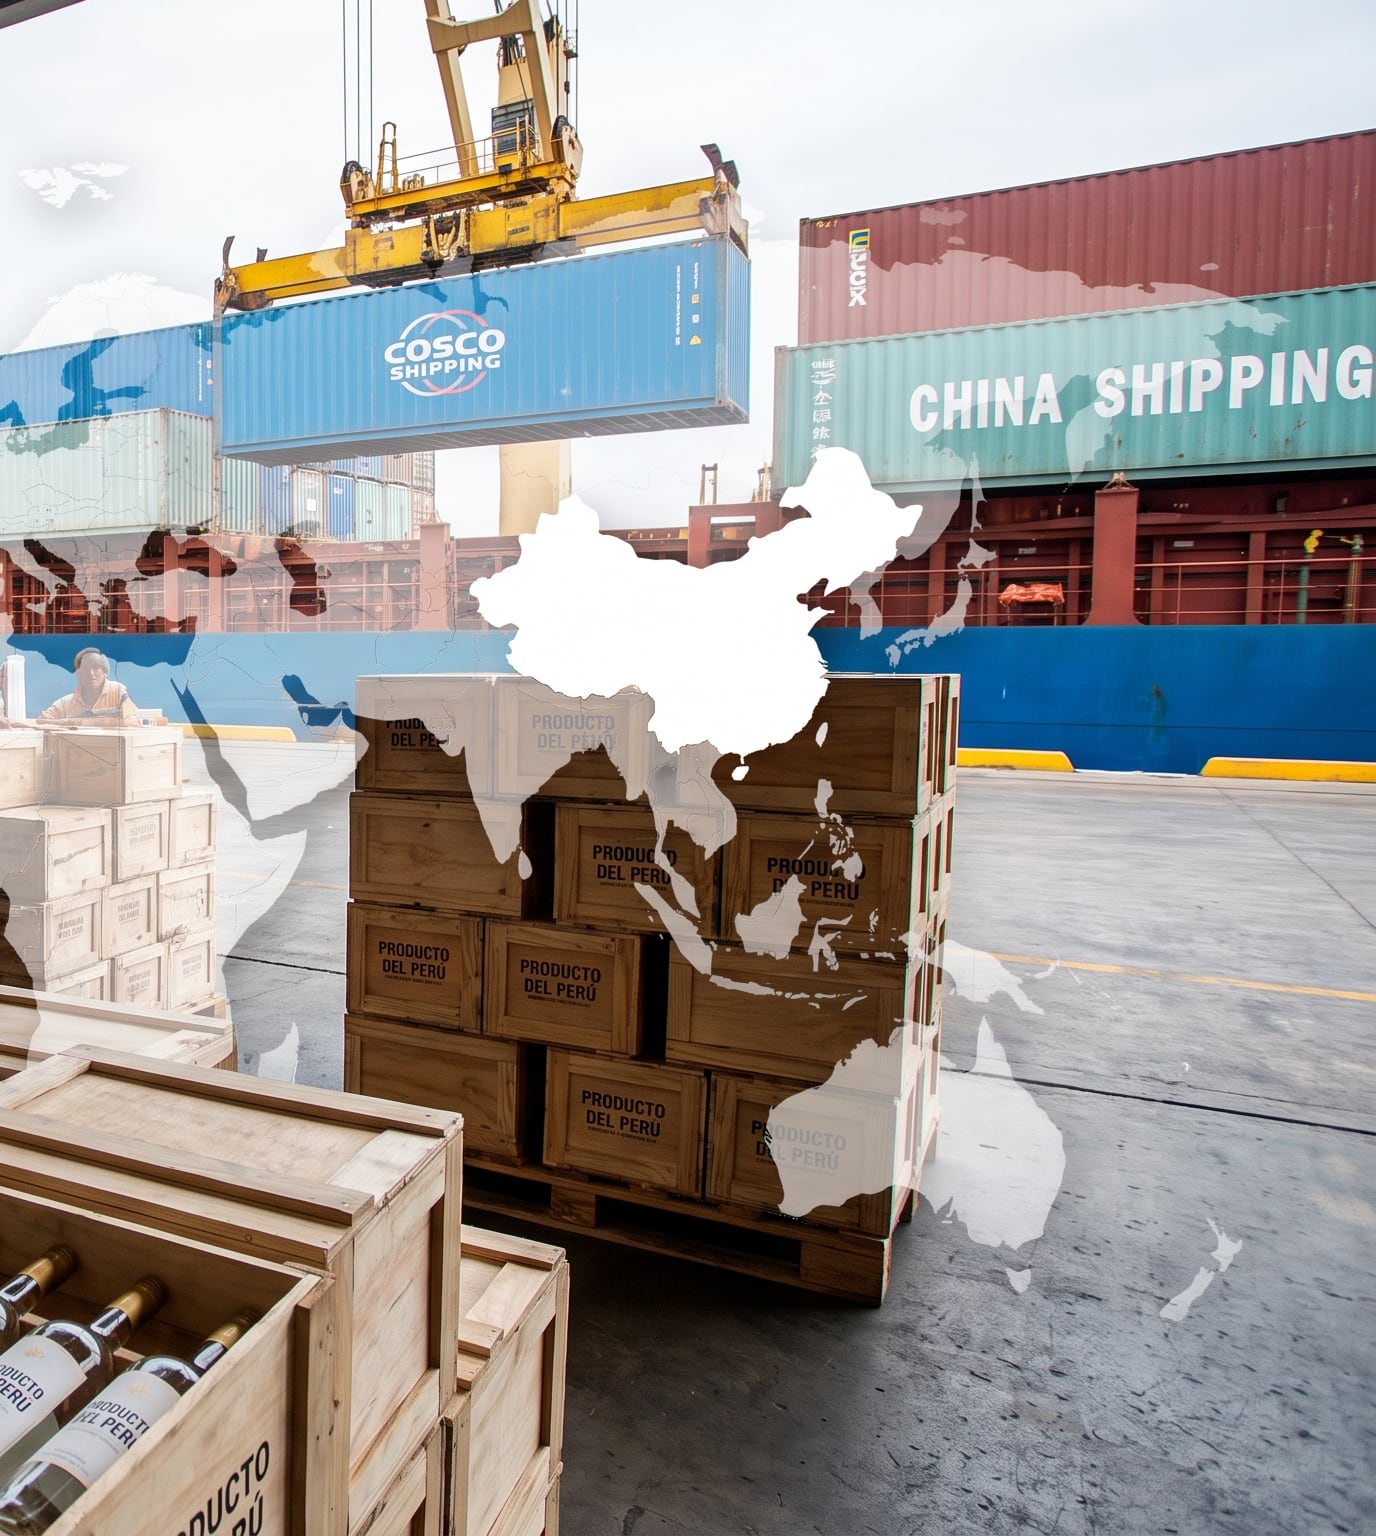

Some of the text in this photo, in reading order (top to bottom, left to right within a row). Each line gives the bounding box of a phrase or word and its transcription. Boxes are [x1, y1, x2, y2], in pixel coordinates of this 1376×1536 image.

[384, 329, 505, 364] COSCO
[390, 354, 501, 380] SHIPPING
[909, 373, 1062, 432] CHINA
[1094, 345, 1373, 417] SHIPPING
[532, 713, 615, 730] PRODUCTO
[391, 733, 416, 747] DEL
[537, 733, 566, 749] DEL
[592, 845, 677, 867] PRODUCO
[597, 864, 626, 881] DEL
[378, 941, 450, 963] PRODUCTO
[383, 959, 407, 975] DEL
[411, 962, 446, 980] PERÚ
[520, 959, 602, 984] PRODUCTO
[525, 978, 552, 995] DEL
[557, 983, 597, 1002] PERÚ
[581, 1089, 666, 1119] PRODUCTO
[586, 1109, 615, 1129] DEL
[87, 1400, 151, 1435] RODUCT
[100, 1416, 137, 1450] PER
[177, 1440, 270, 1536] DUCTO
